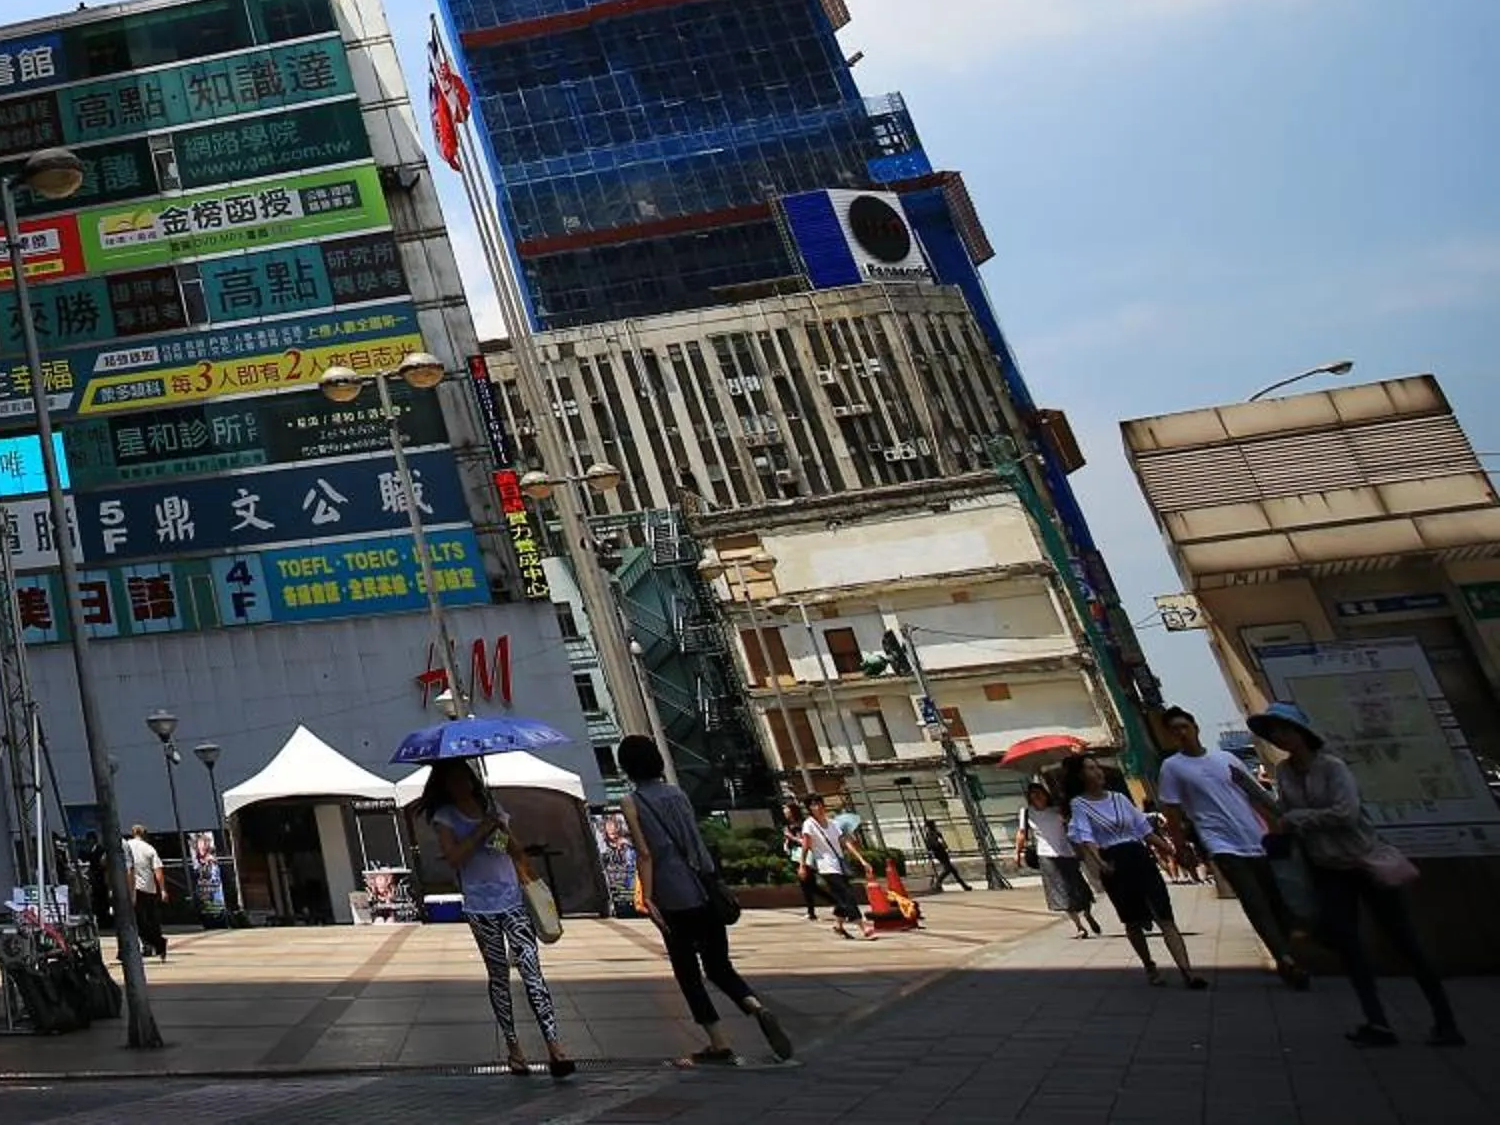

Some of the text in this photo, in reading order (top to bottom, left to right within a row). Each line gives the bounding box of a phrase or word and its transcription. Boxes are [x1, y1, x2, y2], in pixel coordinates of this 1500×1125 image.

[184, 119, 302, 160] 網路學院
[187, 141, 352, 179] www.get.com.tw
[160, 187, 292, 235] 金榜函授
[326, 241, 395, 268] 研究所
[213, 258, 318, 313] 高點
[115, 413, 241, 459] 星和診所
[154, 469, 435, 543] 鼎文公職
[411, 540, 465, 566] ILTS
[416, 634, 513, 709] HM
